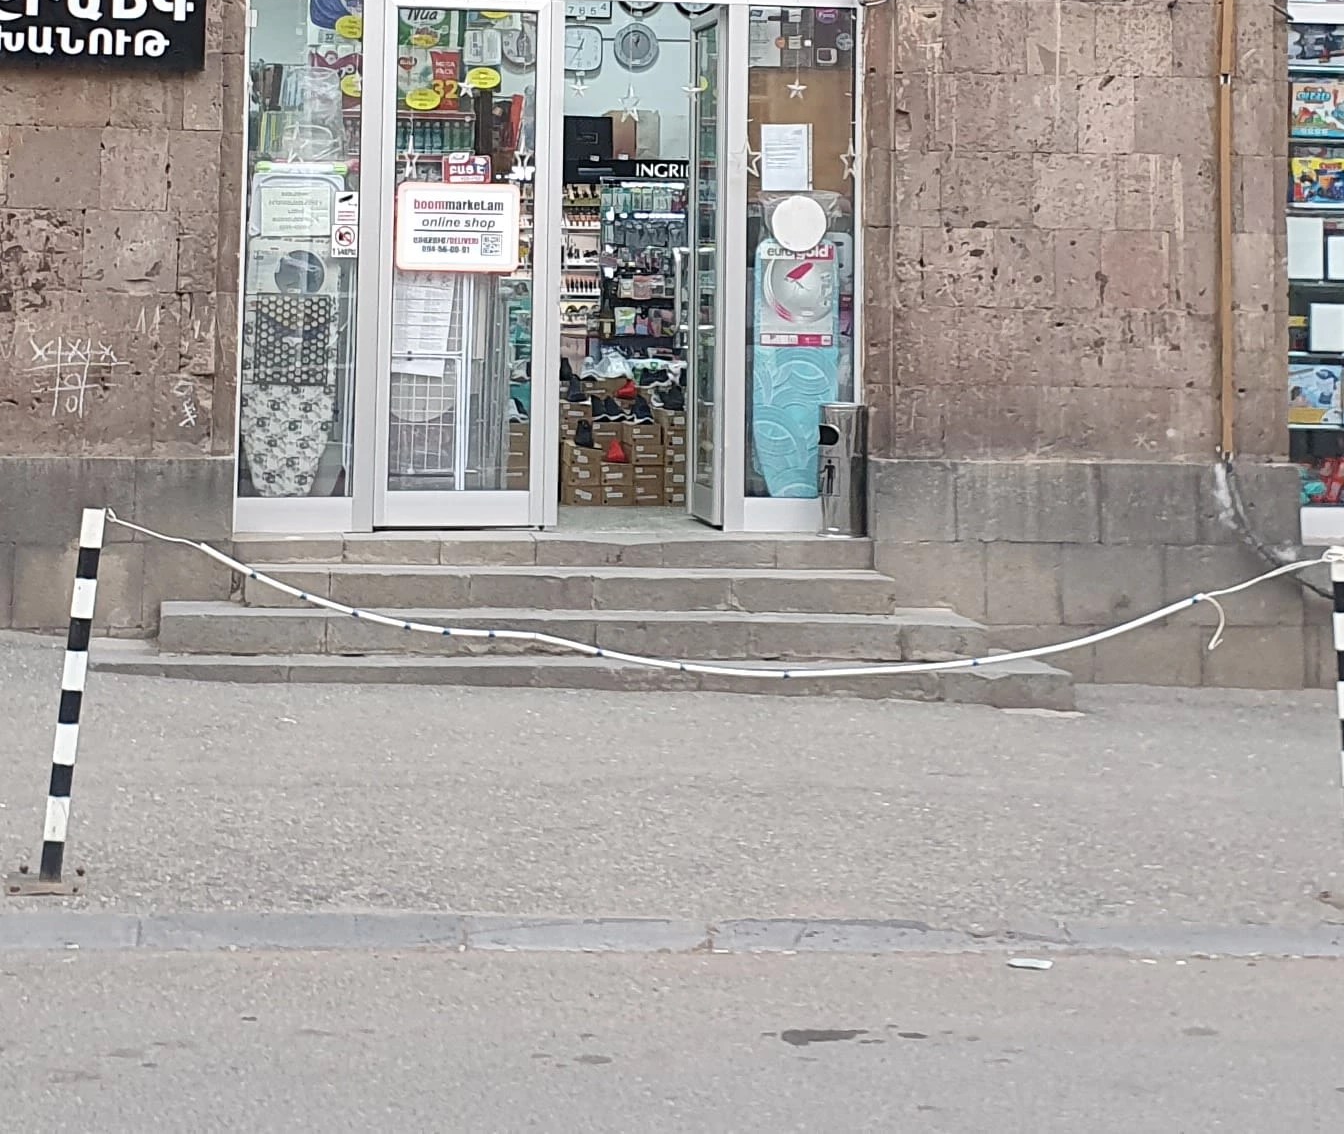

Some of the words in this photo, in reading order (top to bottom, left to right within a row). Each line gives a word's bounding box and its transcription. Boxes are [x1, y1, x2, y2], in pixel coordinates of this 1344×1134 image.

[413, 198, 504, 212] boommarket.am
[421, 217, 461, 228] online
[464, 218, 496, 230] shop
